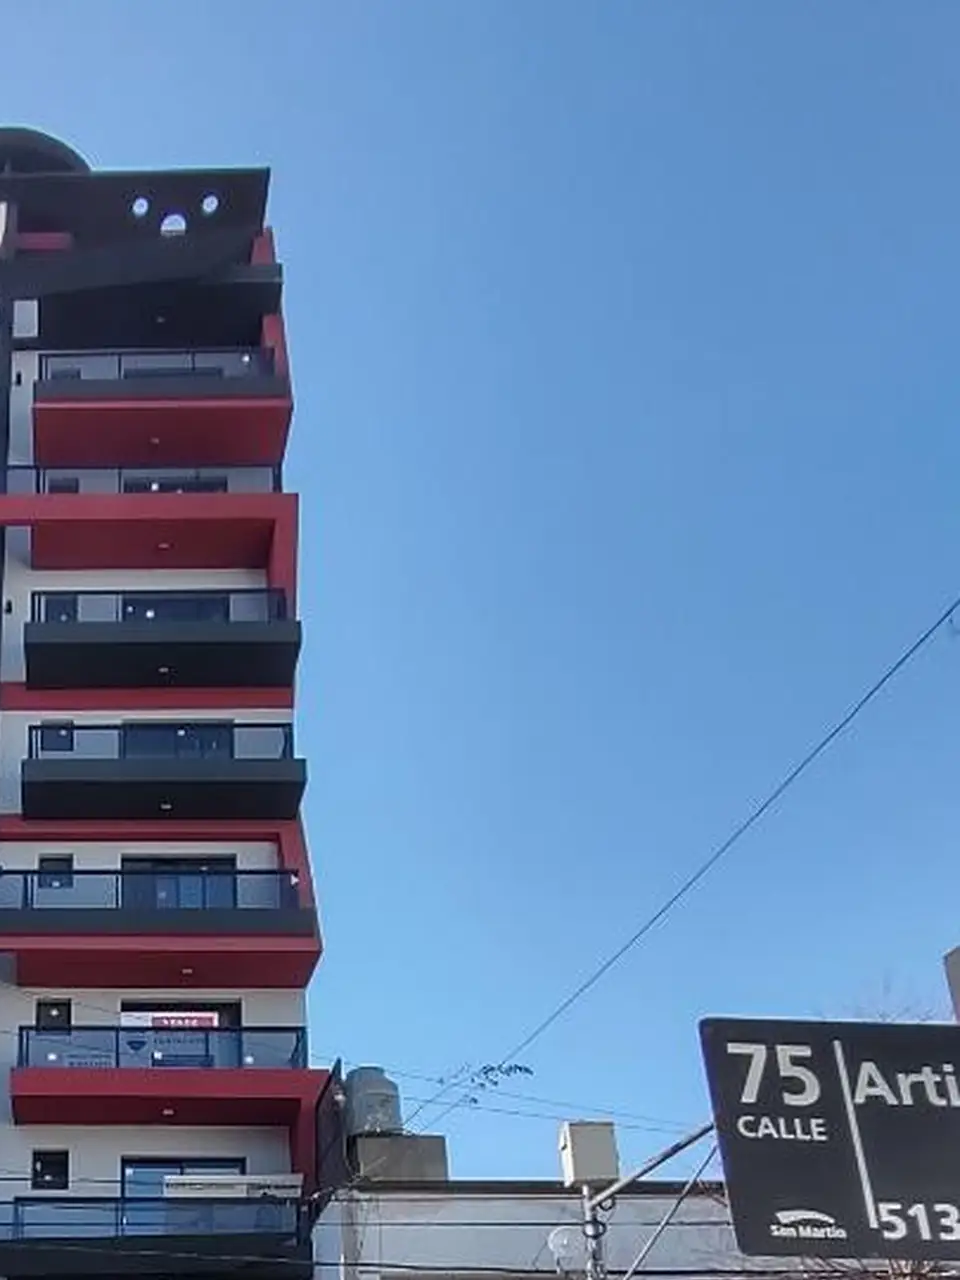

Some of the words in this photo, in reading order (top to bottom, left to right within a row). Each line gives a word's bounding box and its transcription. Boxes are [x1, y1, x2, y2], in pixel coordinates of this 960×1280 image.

[727, 1043, 821, 1106] 75
[854, 1061, 960, 1107] Arti
[737, 1115, 828, 1141] CALLE
[877, 1203, 960, 1240] 513
